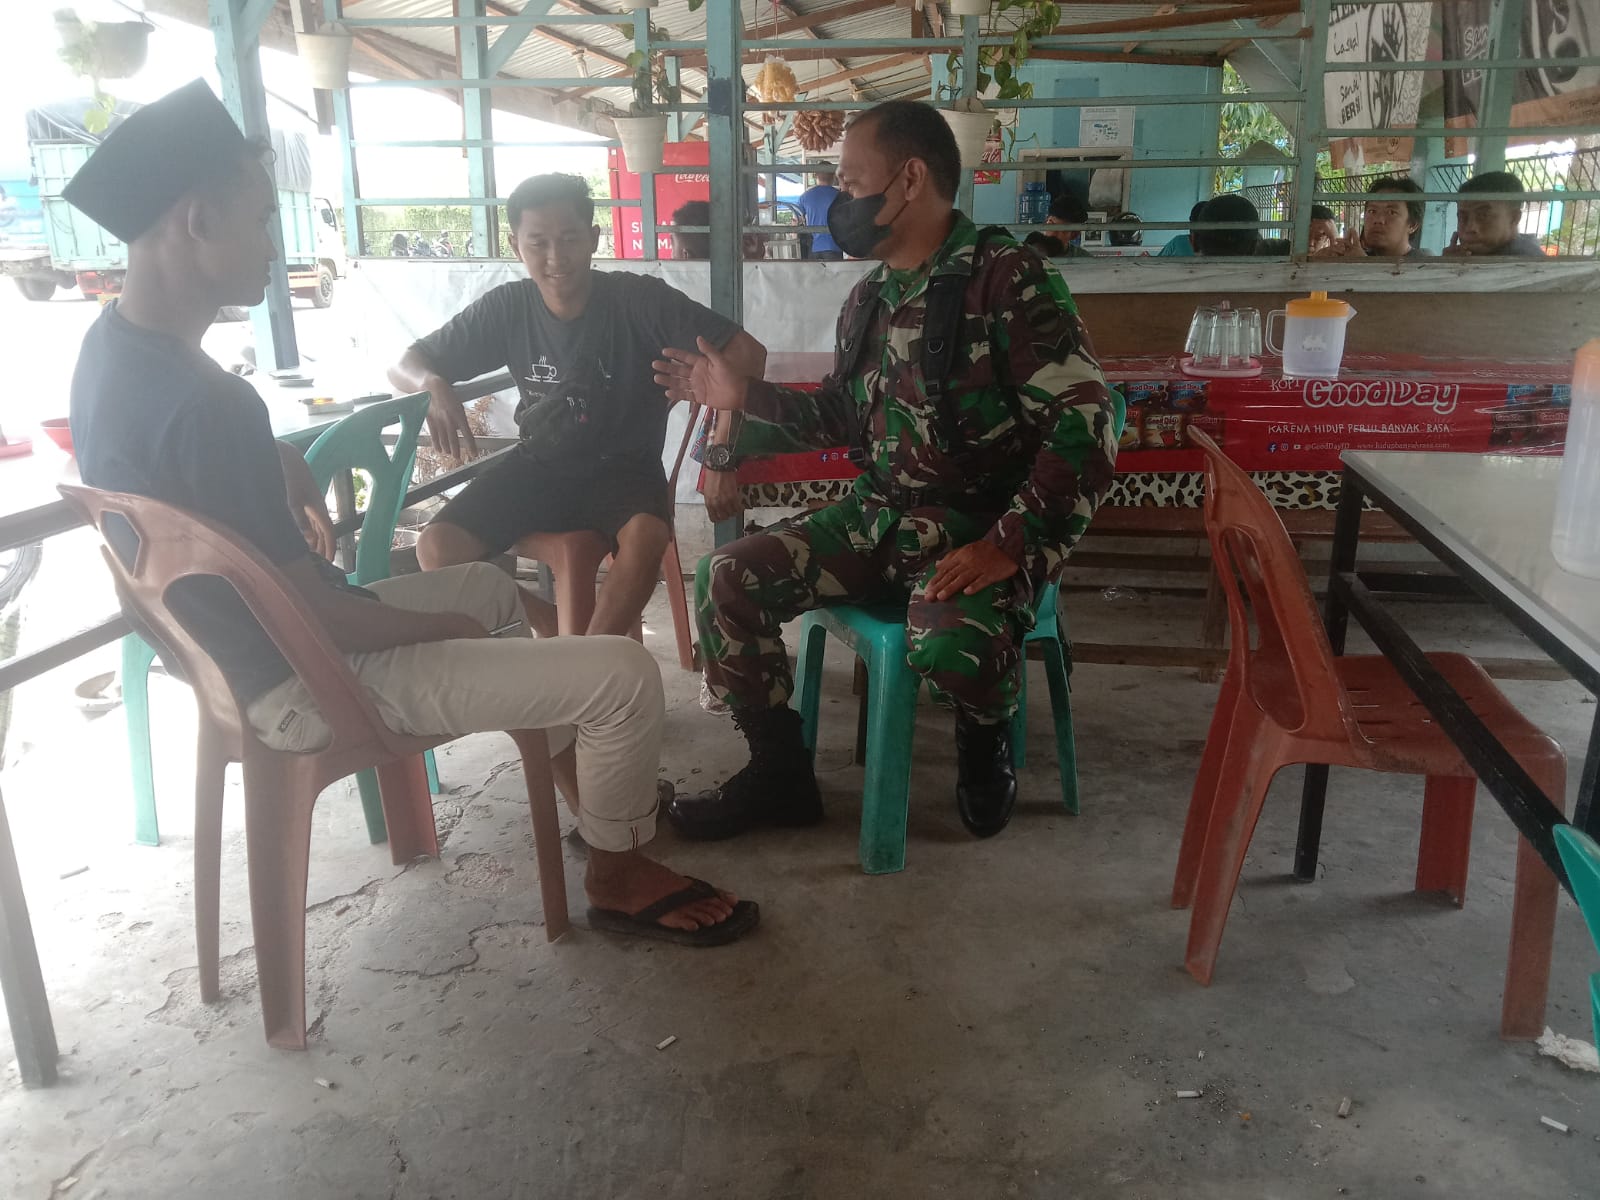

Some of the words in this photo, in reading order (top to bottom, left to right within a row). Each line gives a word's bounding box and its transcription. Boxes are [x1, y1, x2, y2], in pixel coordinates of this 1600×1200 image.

[1268, 423, 1311, 434] KARENA
[1314, 424, 1344, 433] HIDUP
[1381, 424, 1420, 433] BANYAK
[1426, 423, 1450, 433] RASA
